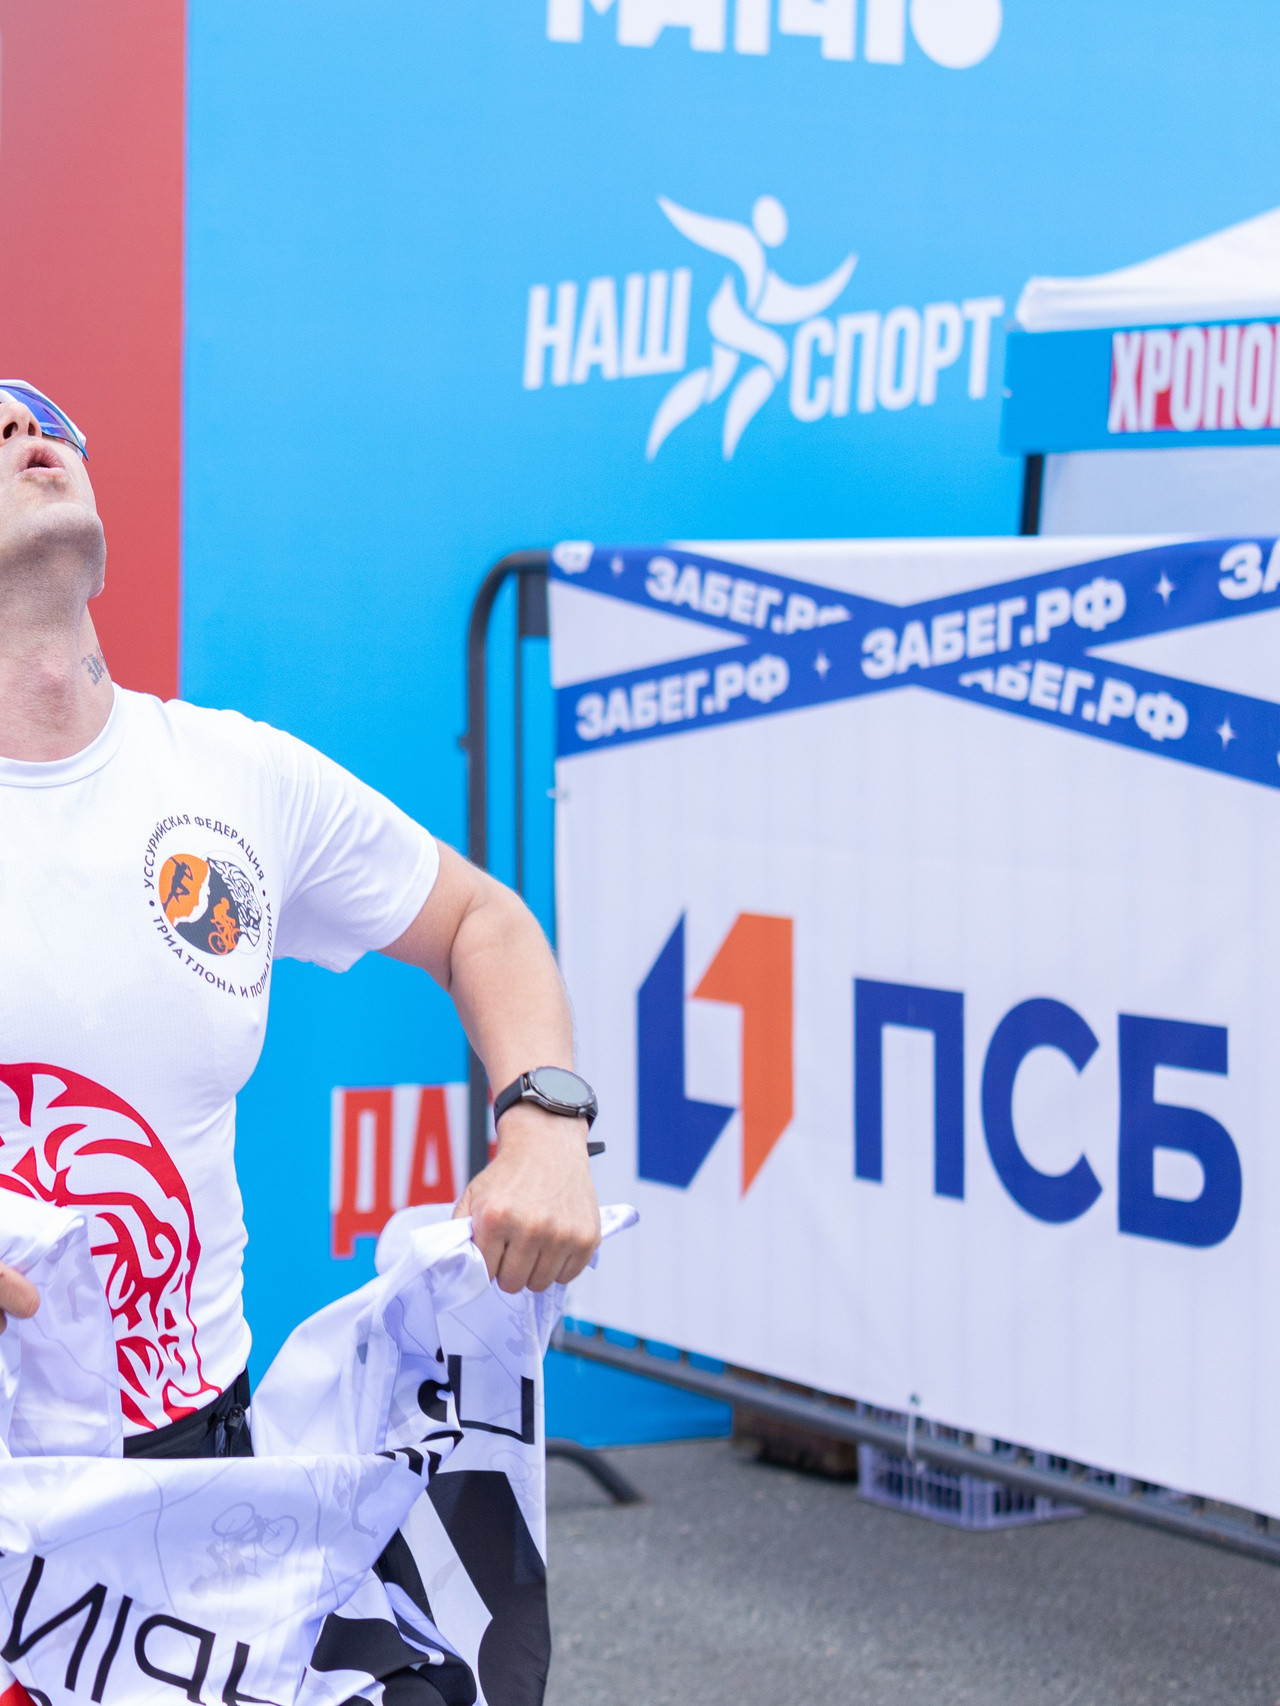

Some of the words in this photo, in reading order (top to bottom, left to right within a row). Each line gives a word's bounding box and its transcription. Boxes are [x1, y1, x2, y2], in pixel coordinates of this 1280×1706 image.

[523, 267, 693, 391] НАШ
[788, 295, 1006, 423] СПОРТ
[1107, 322, 1280, 434] ХРОНО
[860, 576, 1128, 681] ЗАБЕГ.РФ
[575, 653, 791, 742] ЗАБЕГ.РФ
[143, 813, 192, 890] УССУРИЙСКАЯ
[194, 816, 265, 882] ФЕДЕРАЦИЯ
[152, 915, 236, 996] ТРИАТЛОНА
[853, 976, 1243, 1250] ПСБ
[330, 1083, 498, 1260] ДА
